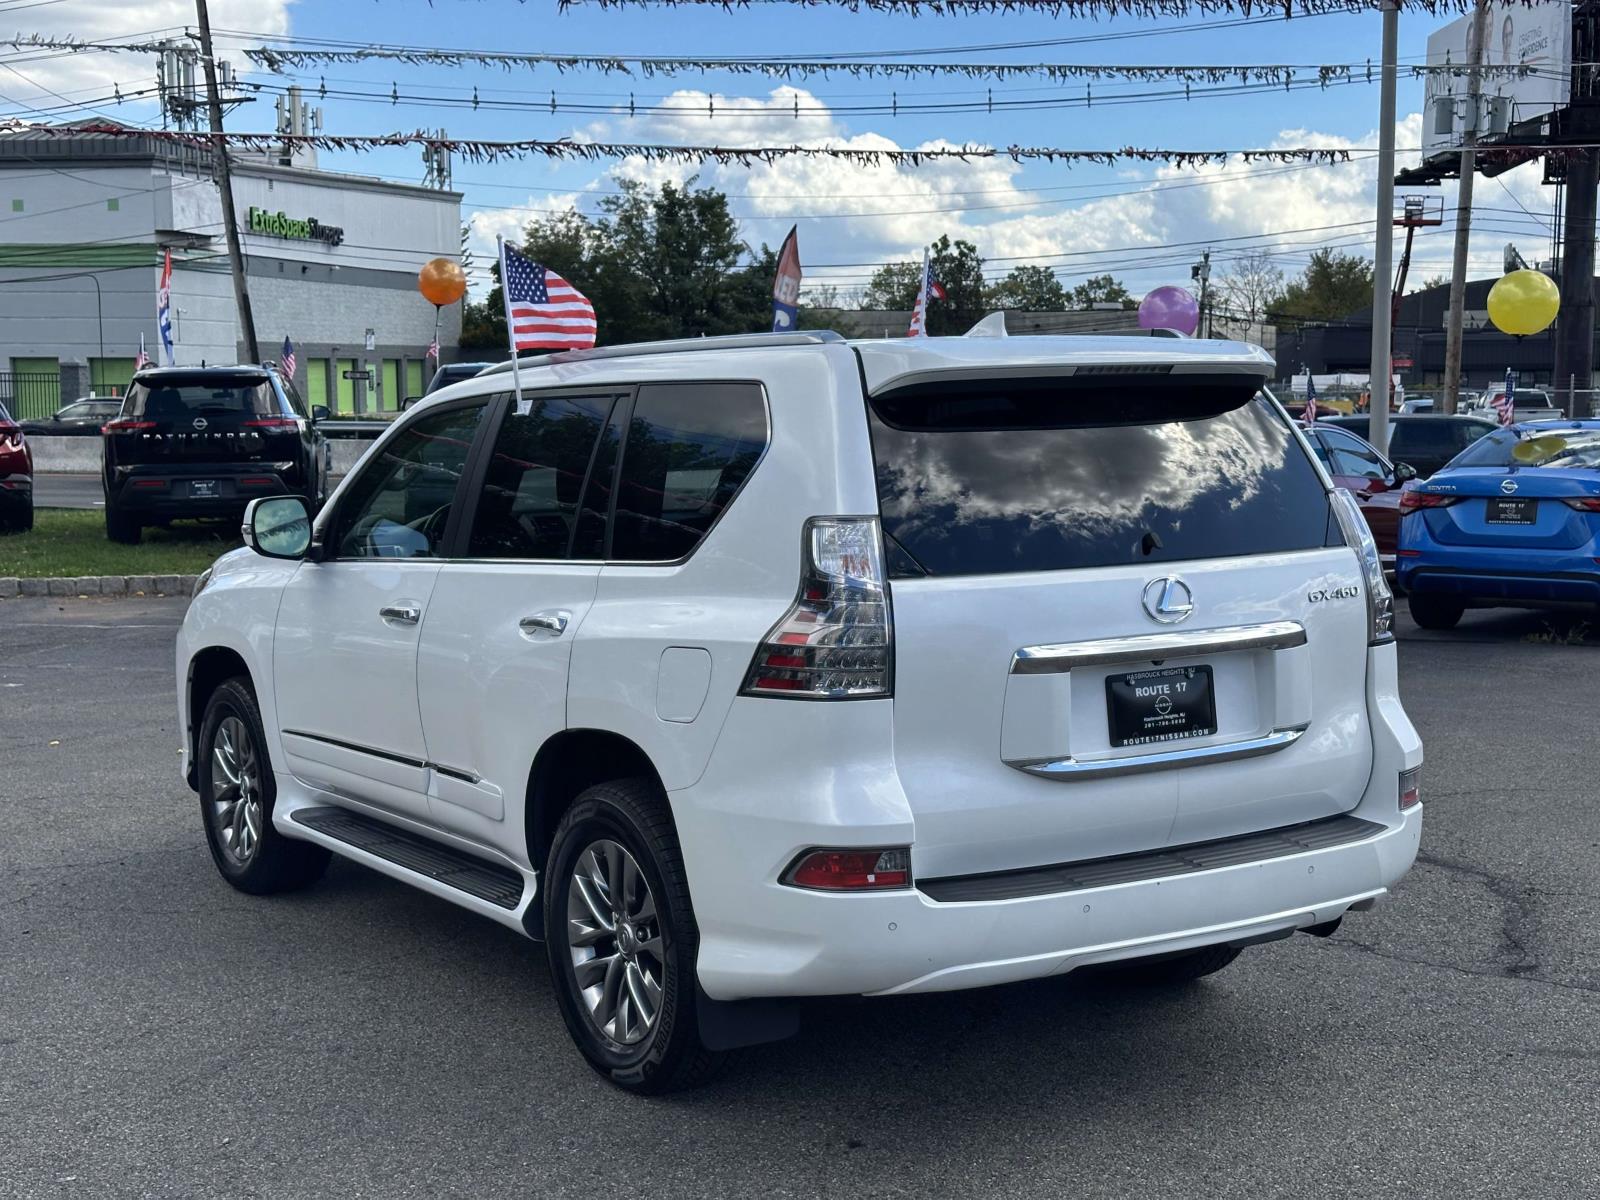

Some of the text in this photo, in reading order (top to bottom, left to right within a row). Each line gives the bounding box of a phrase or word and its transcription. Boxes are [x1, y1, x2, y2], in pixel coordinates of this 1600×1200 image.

[143, 432, 259, 440] PATHFINDER
[1126, 672, 1160, 681] HASBROUCK
[1135, 682, 1187, 697] ROUTE 17
[1123, 728, 1209, 746] ROUTE17NISSAN.COM
